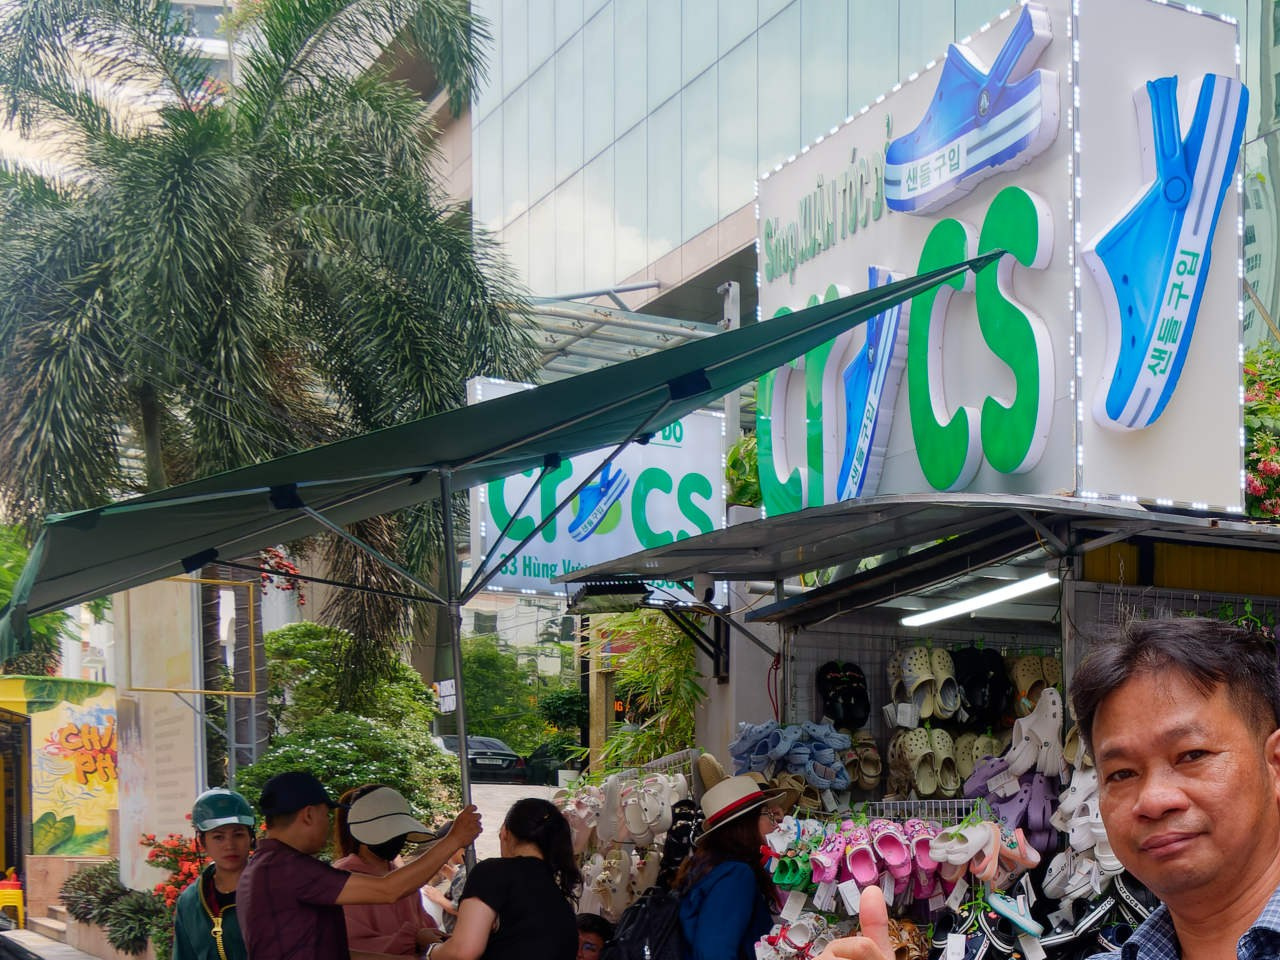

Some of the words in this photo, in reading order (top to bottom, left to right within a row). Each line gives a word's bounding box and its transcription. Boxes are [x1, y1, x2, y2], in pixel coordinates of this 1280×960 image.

[905, 144, 960, 192] 샌들구입
[1147, 249, 1201, 377] 샌들구입
[522, 555, 558, 580] Hùng
[1119, 886, 1140, 909] crocs
